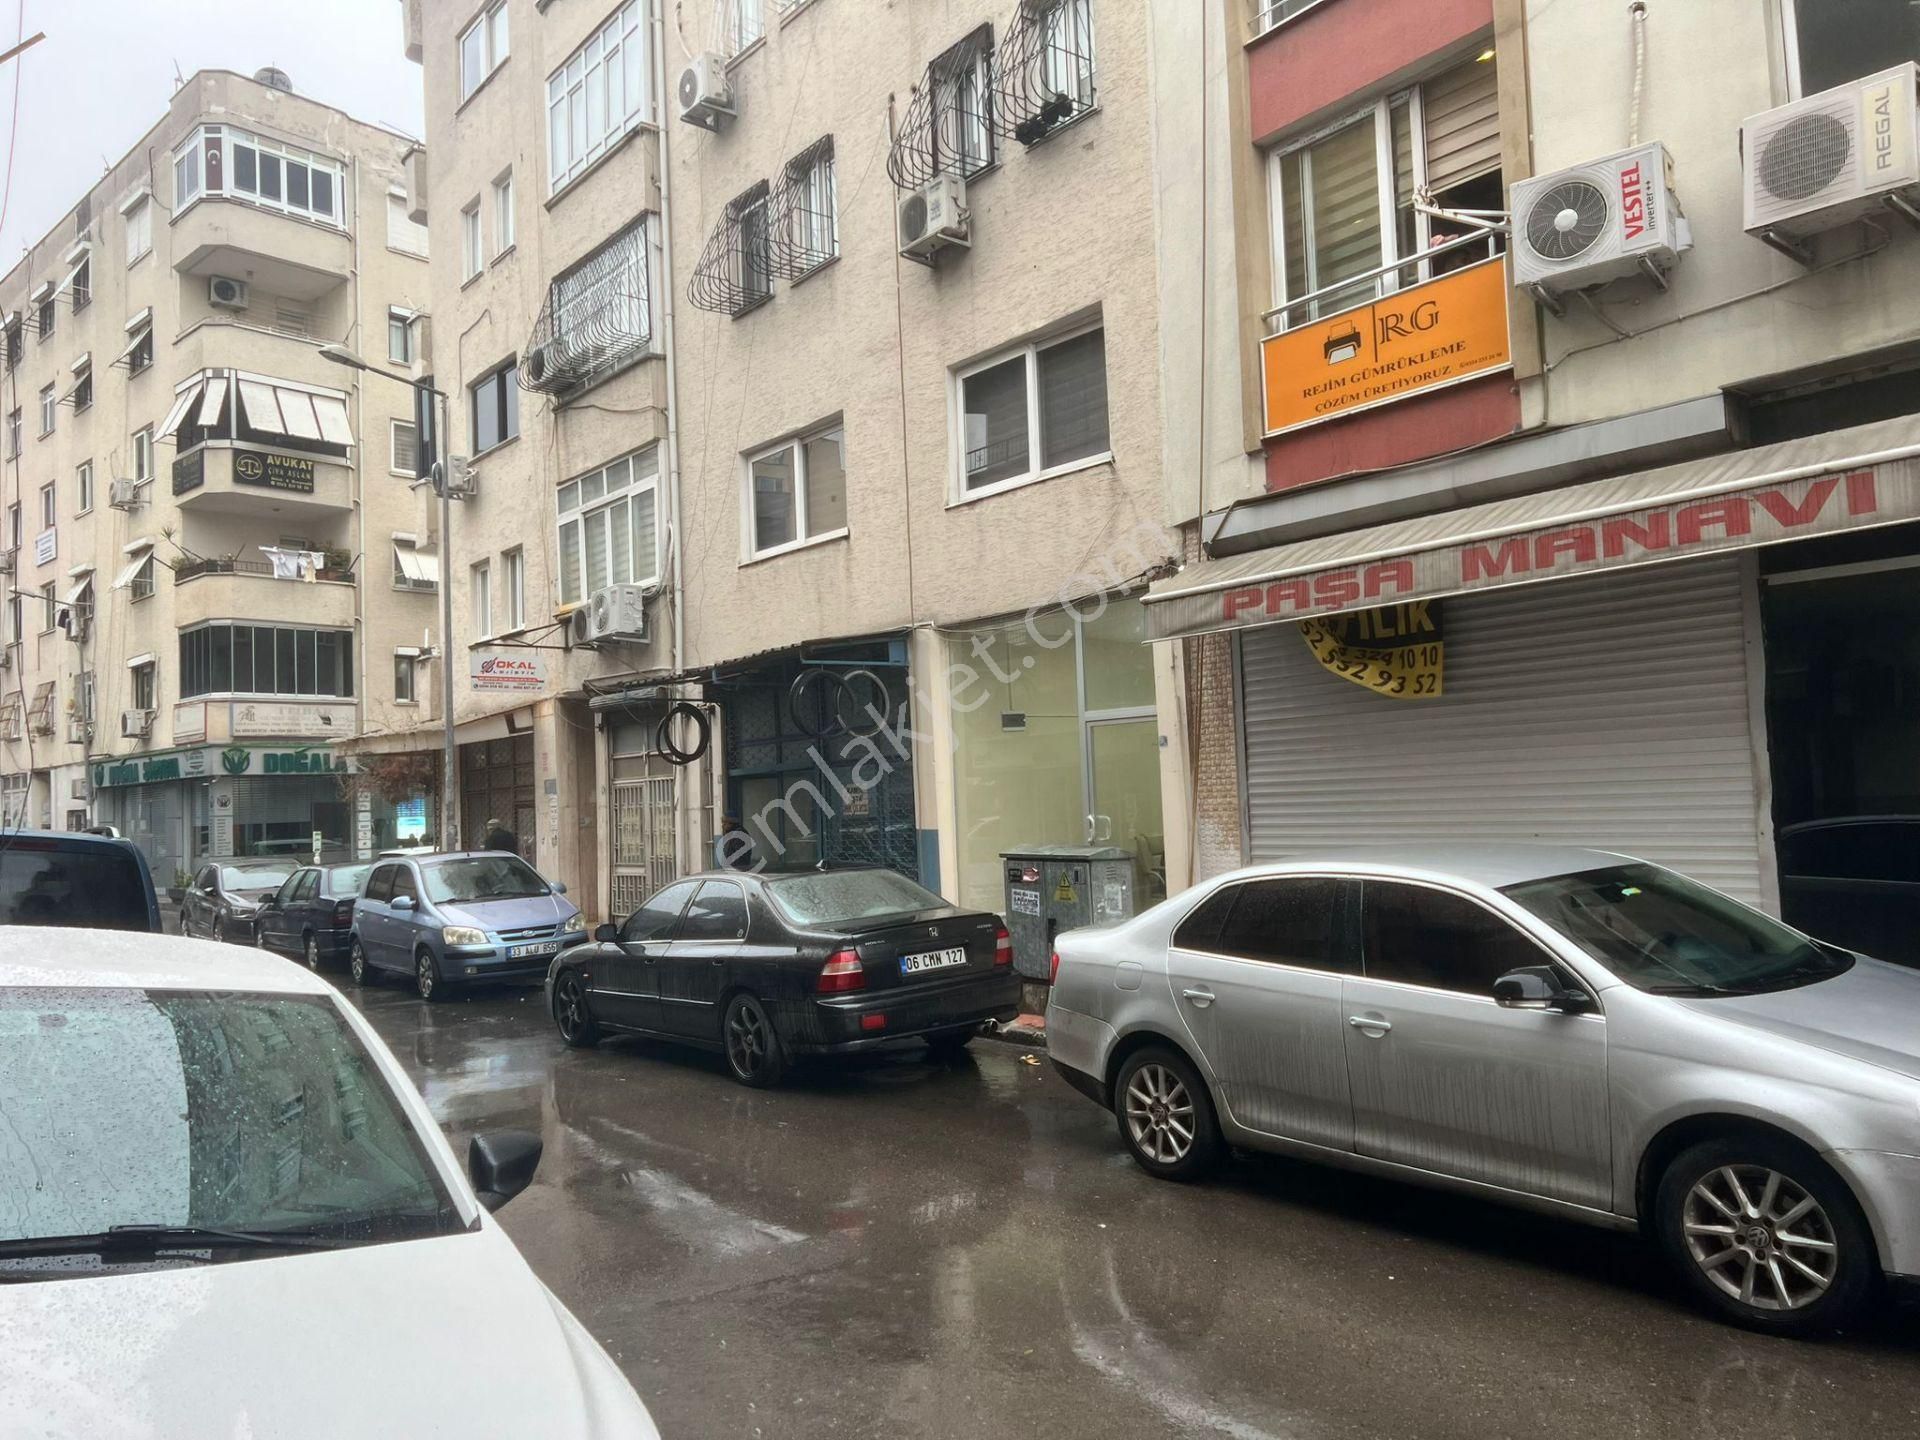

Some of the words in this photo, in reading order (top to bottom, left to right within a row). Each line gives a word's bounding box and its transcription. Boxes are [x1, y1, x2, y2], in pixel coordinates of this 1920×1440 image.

[1875, 87, 1892, 170] REGAL
[1621, 160, 1643, 240] VESTEL
[1378, 300, 1440, 345] RG
[1303, 376, 1346, 398] REJİM
[1350, 341, 1466, 383] GÜMRÜKLEME
[1315, 391, 1360, 413] ÇÖZÜM
[1364, 365, 1451, 398] ÜRETİYORUZ
[267, 455, 313, 470] AVUKAT
[1222, 560, 1413, 621] PAŞA
[1462, 471, 1878, 582] MANAVI
[1400, 647, 1416, 669] 10
[1421, 646, 1438, 668] 10
[1373, 670, 1407, 694] 93
[1413, 673, 1437, 695] 52
[906, 956, 919, 971] 06
[922, 953, 942, 969] CMN
[946, 949, 963, 964] 127
